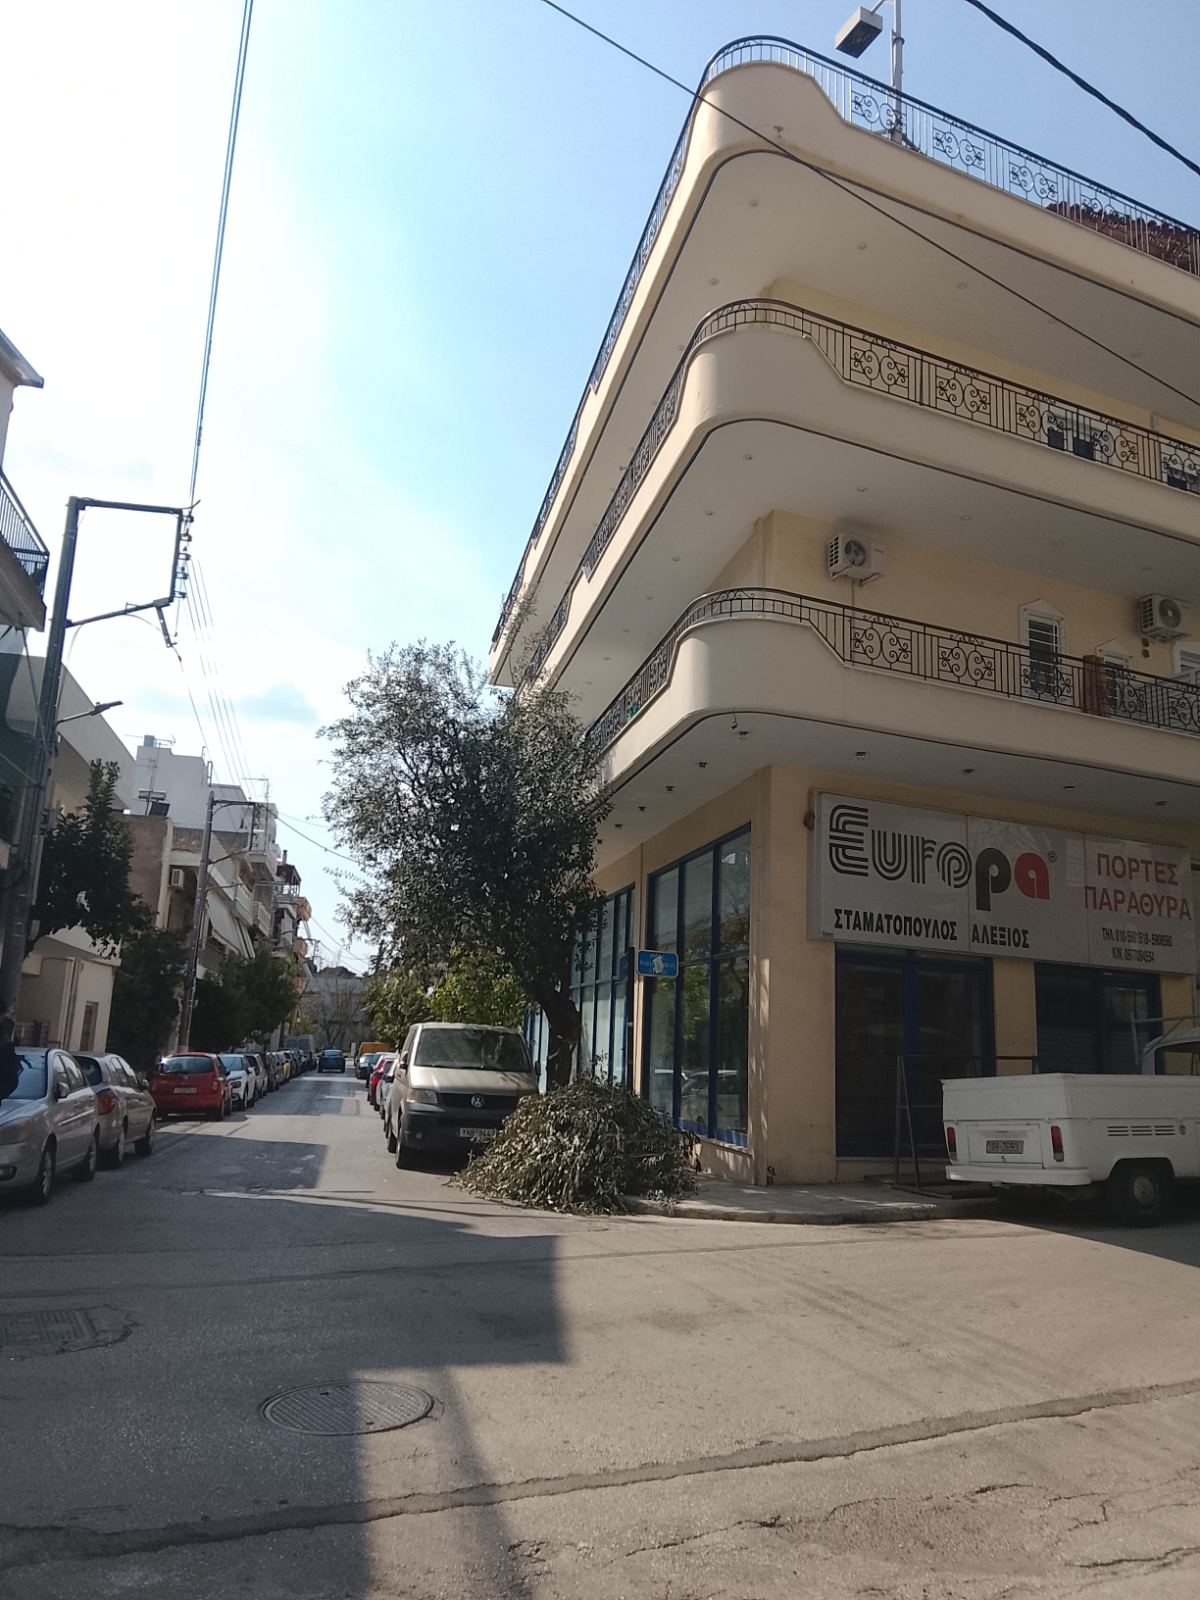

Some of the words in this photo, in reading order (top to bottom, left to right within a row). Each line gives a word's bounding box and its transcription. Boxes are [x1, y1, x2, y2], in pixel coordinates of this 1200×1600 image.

[828, 804, 1051, 912] Europa
[1096, 852, 1179, 886] ΠΟΡΤΕΣ
[1084, 885, 1193, 921] ΠΑΡΑΘΥΡΑ
[833, 908, 958, 942] ΣΤΑΜΑΤΟΠΟΥΛΟΣ
[971, 924, 1030, 949] ΑΛΕΞΙΟΣ
